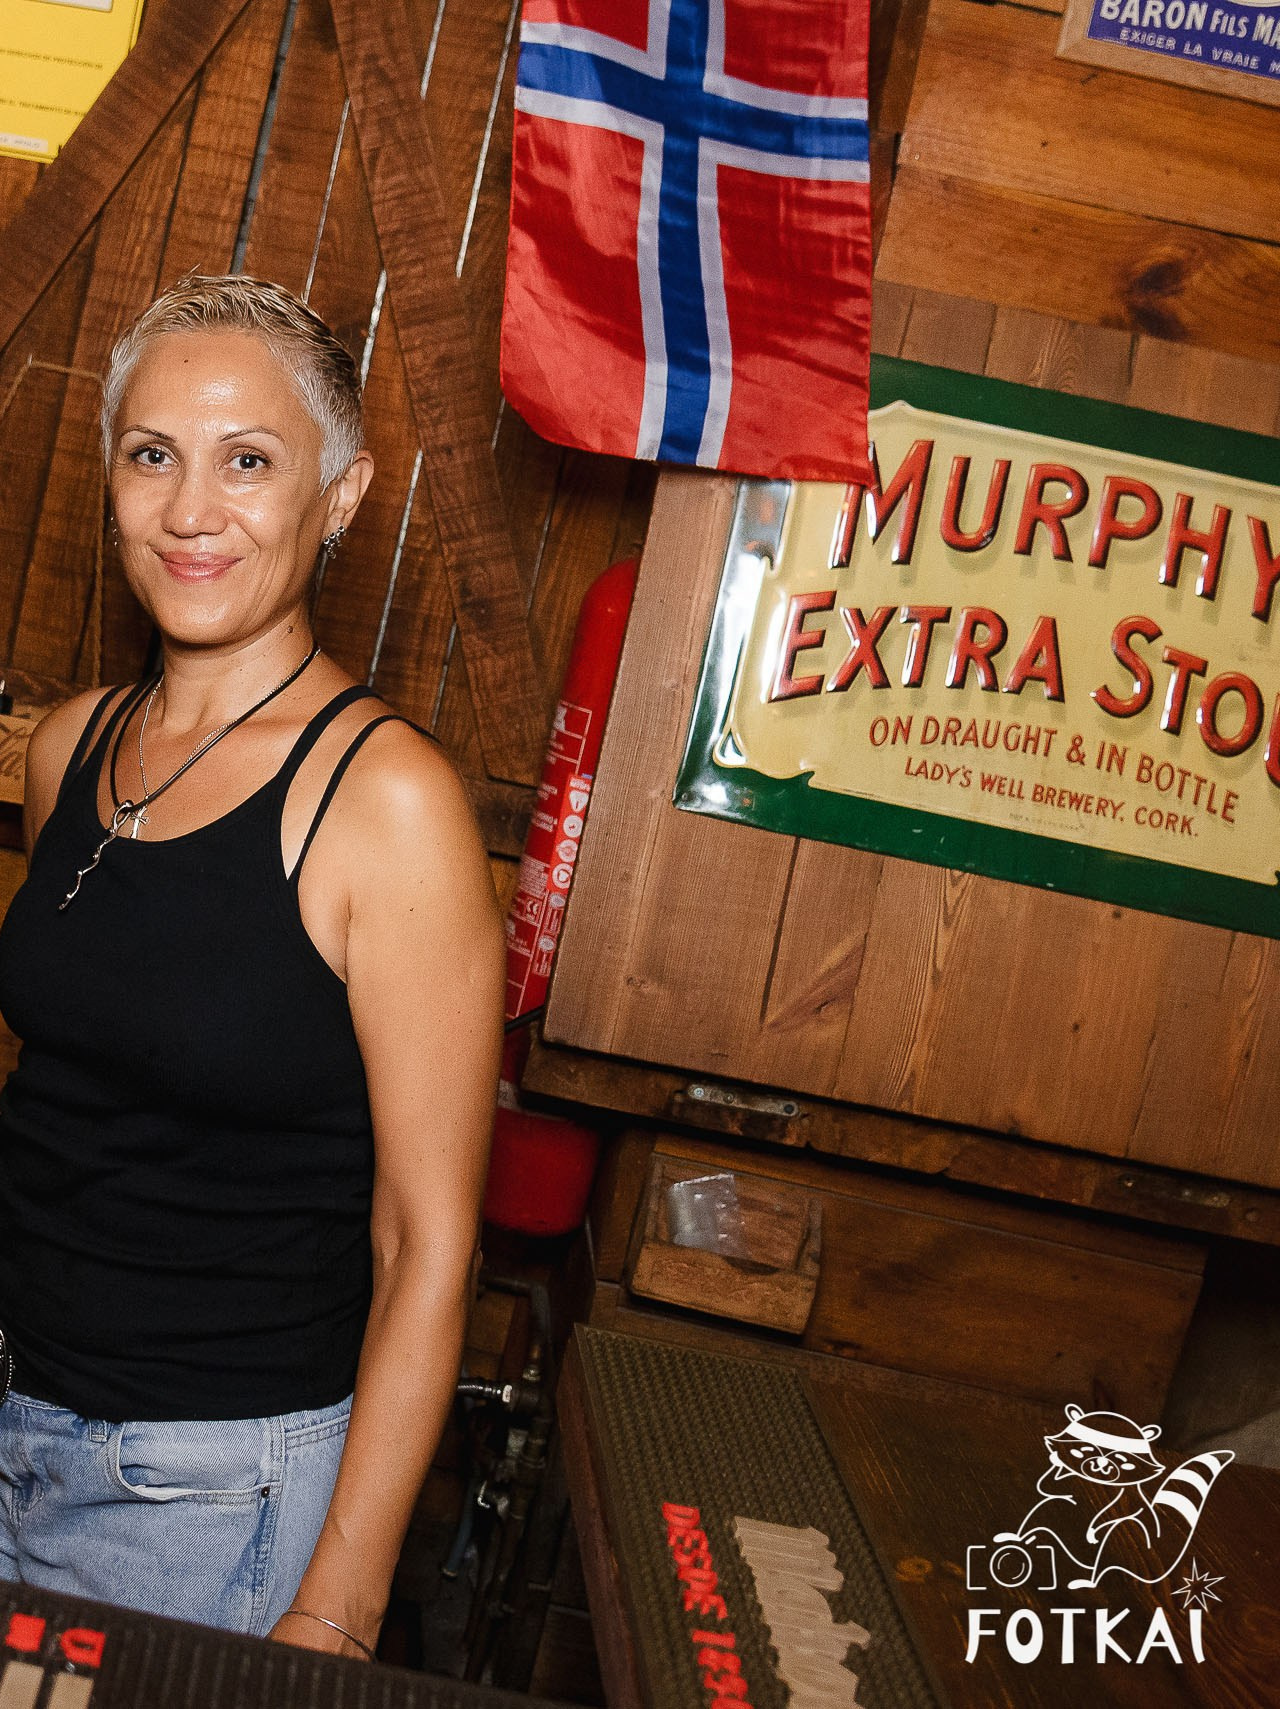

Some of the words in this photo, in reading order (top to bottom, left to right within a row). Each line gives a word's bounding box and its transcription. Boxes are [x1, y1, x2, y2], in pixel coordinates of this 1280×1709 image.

[1099, 0, 1208, 31] BARON
[1209, 8, 1250, 38] FILS
[1119, 27, 1177, 51] EXIGER
[1183, 41, 1203, 57] LA
[1211, 46, 1261, 70] VRAIE
[767, 590, 1065, 704] EXTRA
[869, 714, 913, 747] ON
[920, 715, 1058, 759] DRAUGHT
[1066, 733, 1086, 765] &
[1096, 739, 1128, 776] IN
[1135, 756, 1241, 825] BOTTLE
[904, 757, 972, 787] LADY'S
[979, 771, 1025, 800] WELL
[1133, 805, 1200, 838] CORK.
